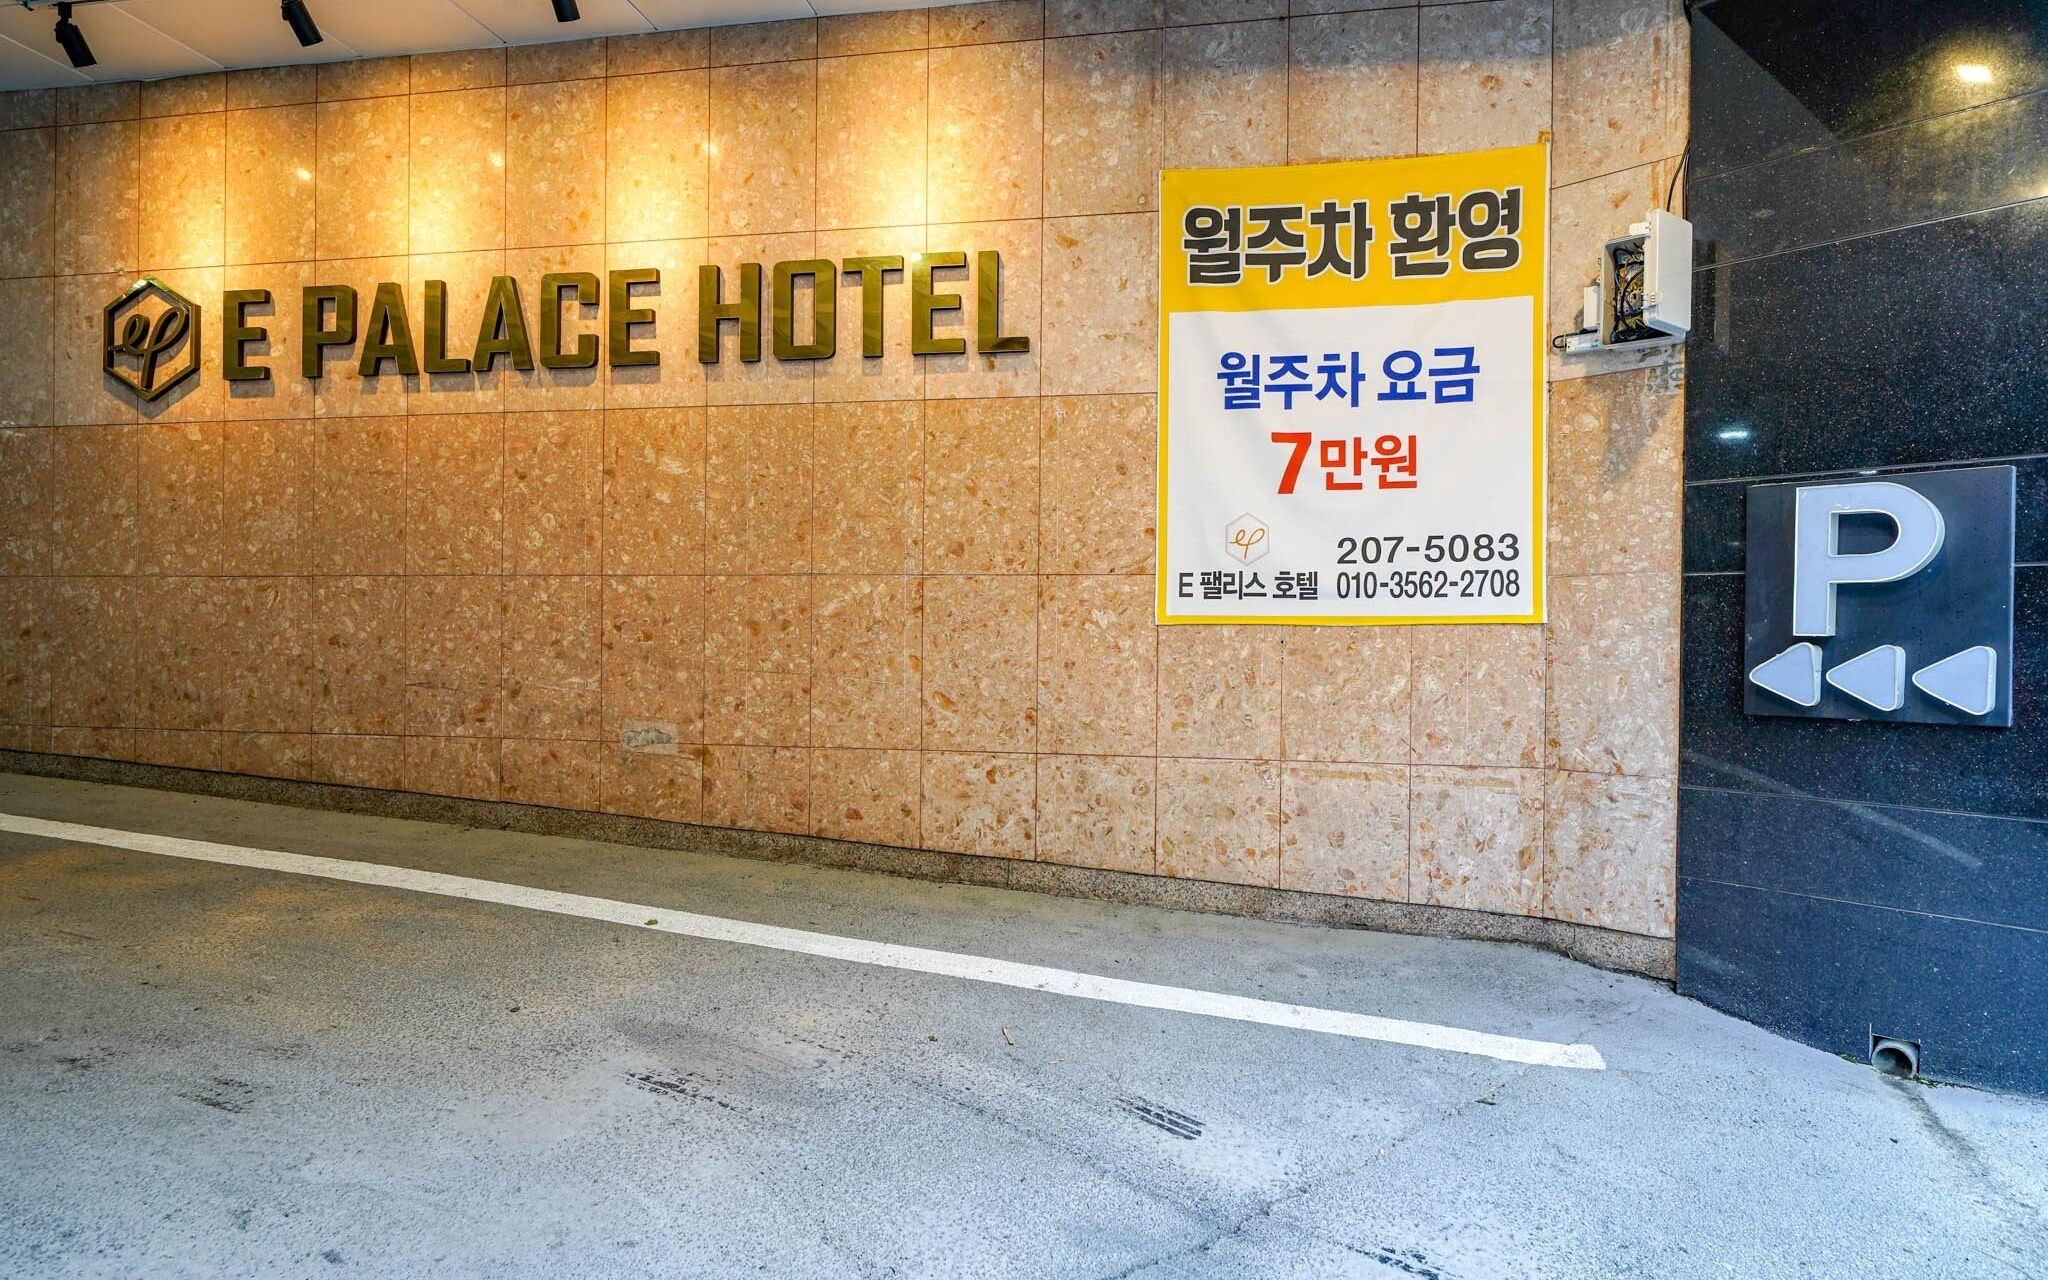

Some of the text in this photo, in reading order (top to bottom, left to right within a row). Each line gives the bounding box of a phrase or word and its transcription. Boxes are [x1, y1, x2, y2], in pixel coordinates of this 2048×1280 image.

[1183, 186, 1524, 285] 월주차 환영
[223, 250, 1031, 381] E PALACE HOTEL
[1217, 346, 1481, 410] 월주차 요금
[1271, 432, 1418, 494] 7만원
[1336, 533, 1520, 565] 207-5083
[1792, 482, 1946, 636] P
[1178, 570, 1319, 600] E 팰리스 호텔
[1336, 568, 1521, 599] 010-3562-2708
